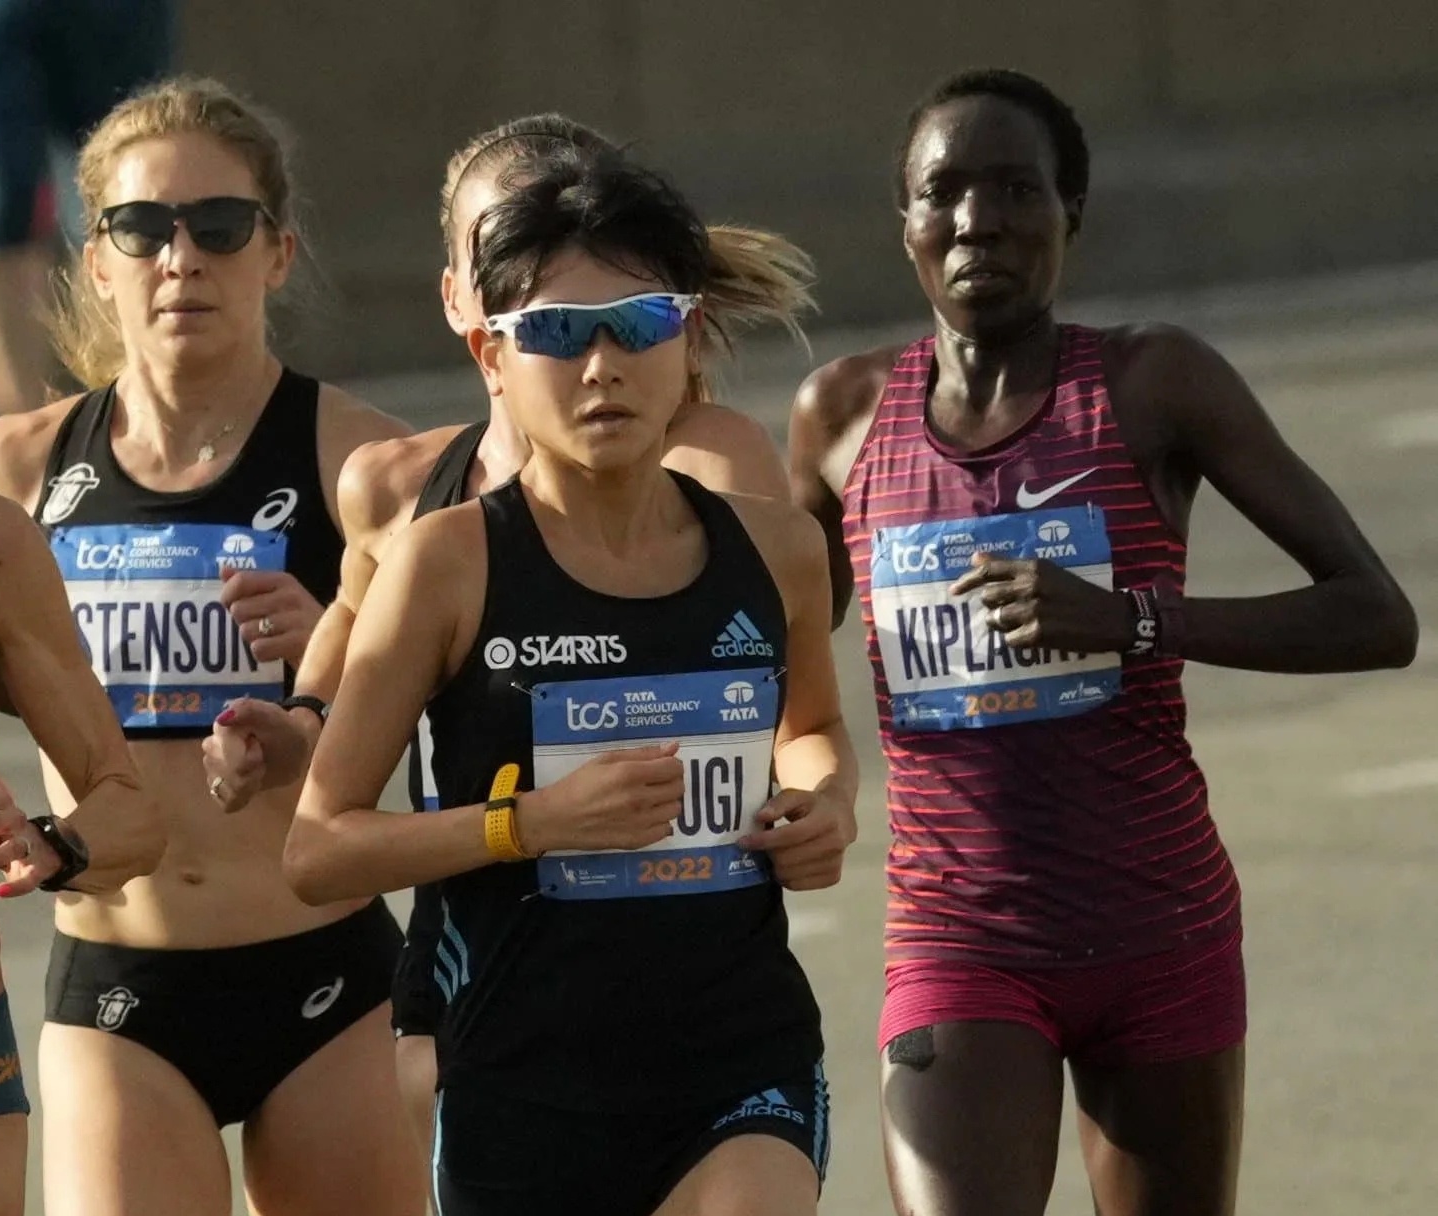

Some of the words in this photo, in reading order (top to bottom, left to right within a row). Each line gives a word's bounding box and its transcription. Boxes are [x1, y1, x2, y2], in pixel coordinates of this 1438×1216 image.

[77, 538, 125, 570] tcs
[129, 546, 199, 557] CONSULTANCY
[893, 541, 940, 573] tcs
[1035, 544, 1077, 559] TATA
[128, 557, 173, 569] SERVICES
[216, 555, 257, 570] TATA
[711, 638, 773, 658] adidas
[133, 692, 202, 714] 2022
[624, 692, 656, 702] TATA
[964, 689, 1038, 716] 2022
[566, 697, 619, 730] tcs
[625, 700, 701, 715] CONSULTANCY
[720, 707, 759, 721] TATA
[625, 714, 673, 727] SERVICES
[638, 857, 713, 883] 2022
[711, 1103, 805, 1130] adidas
